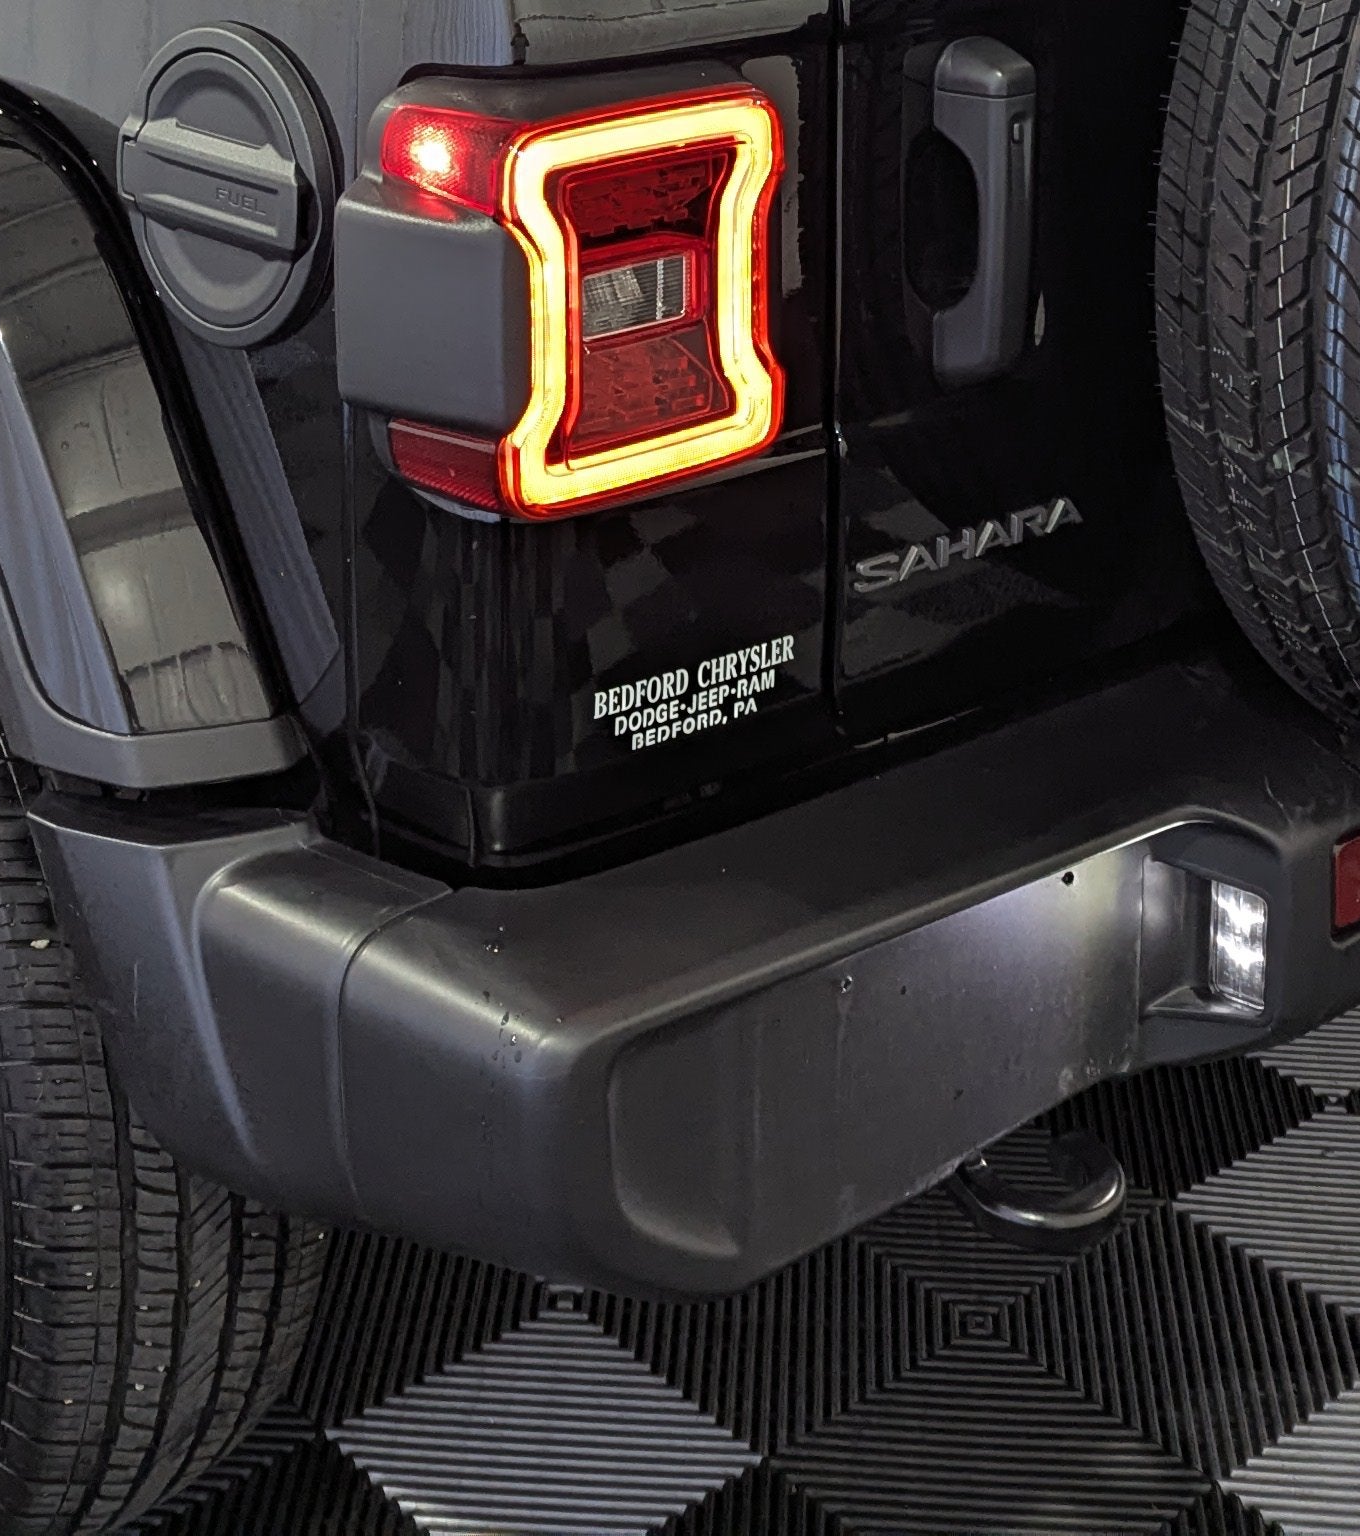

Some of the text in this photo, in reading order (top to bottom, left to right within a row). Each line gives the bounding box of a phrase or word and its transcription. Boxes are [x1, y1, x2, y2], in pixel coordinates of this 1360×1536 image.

[216, 187, 267, 216] FUEL
[853, 497, 1084, 594] SAHARA
[594, 634, 795, 720] BEDFORD CHRYSLER
[631, 697, 758, 751] BEDFORD, PA
